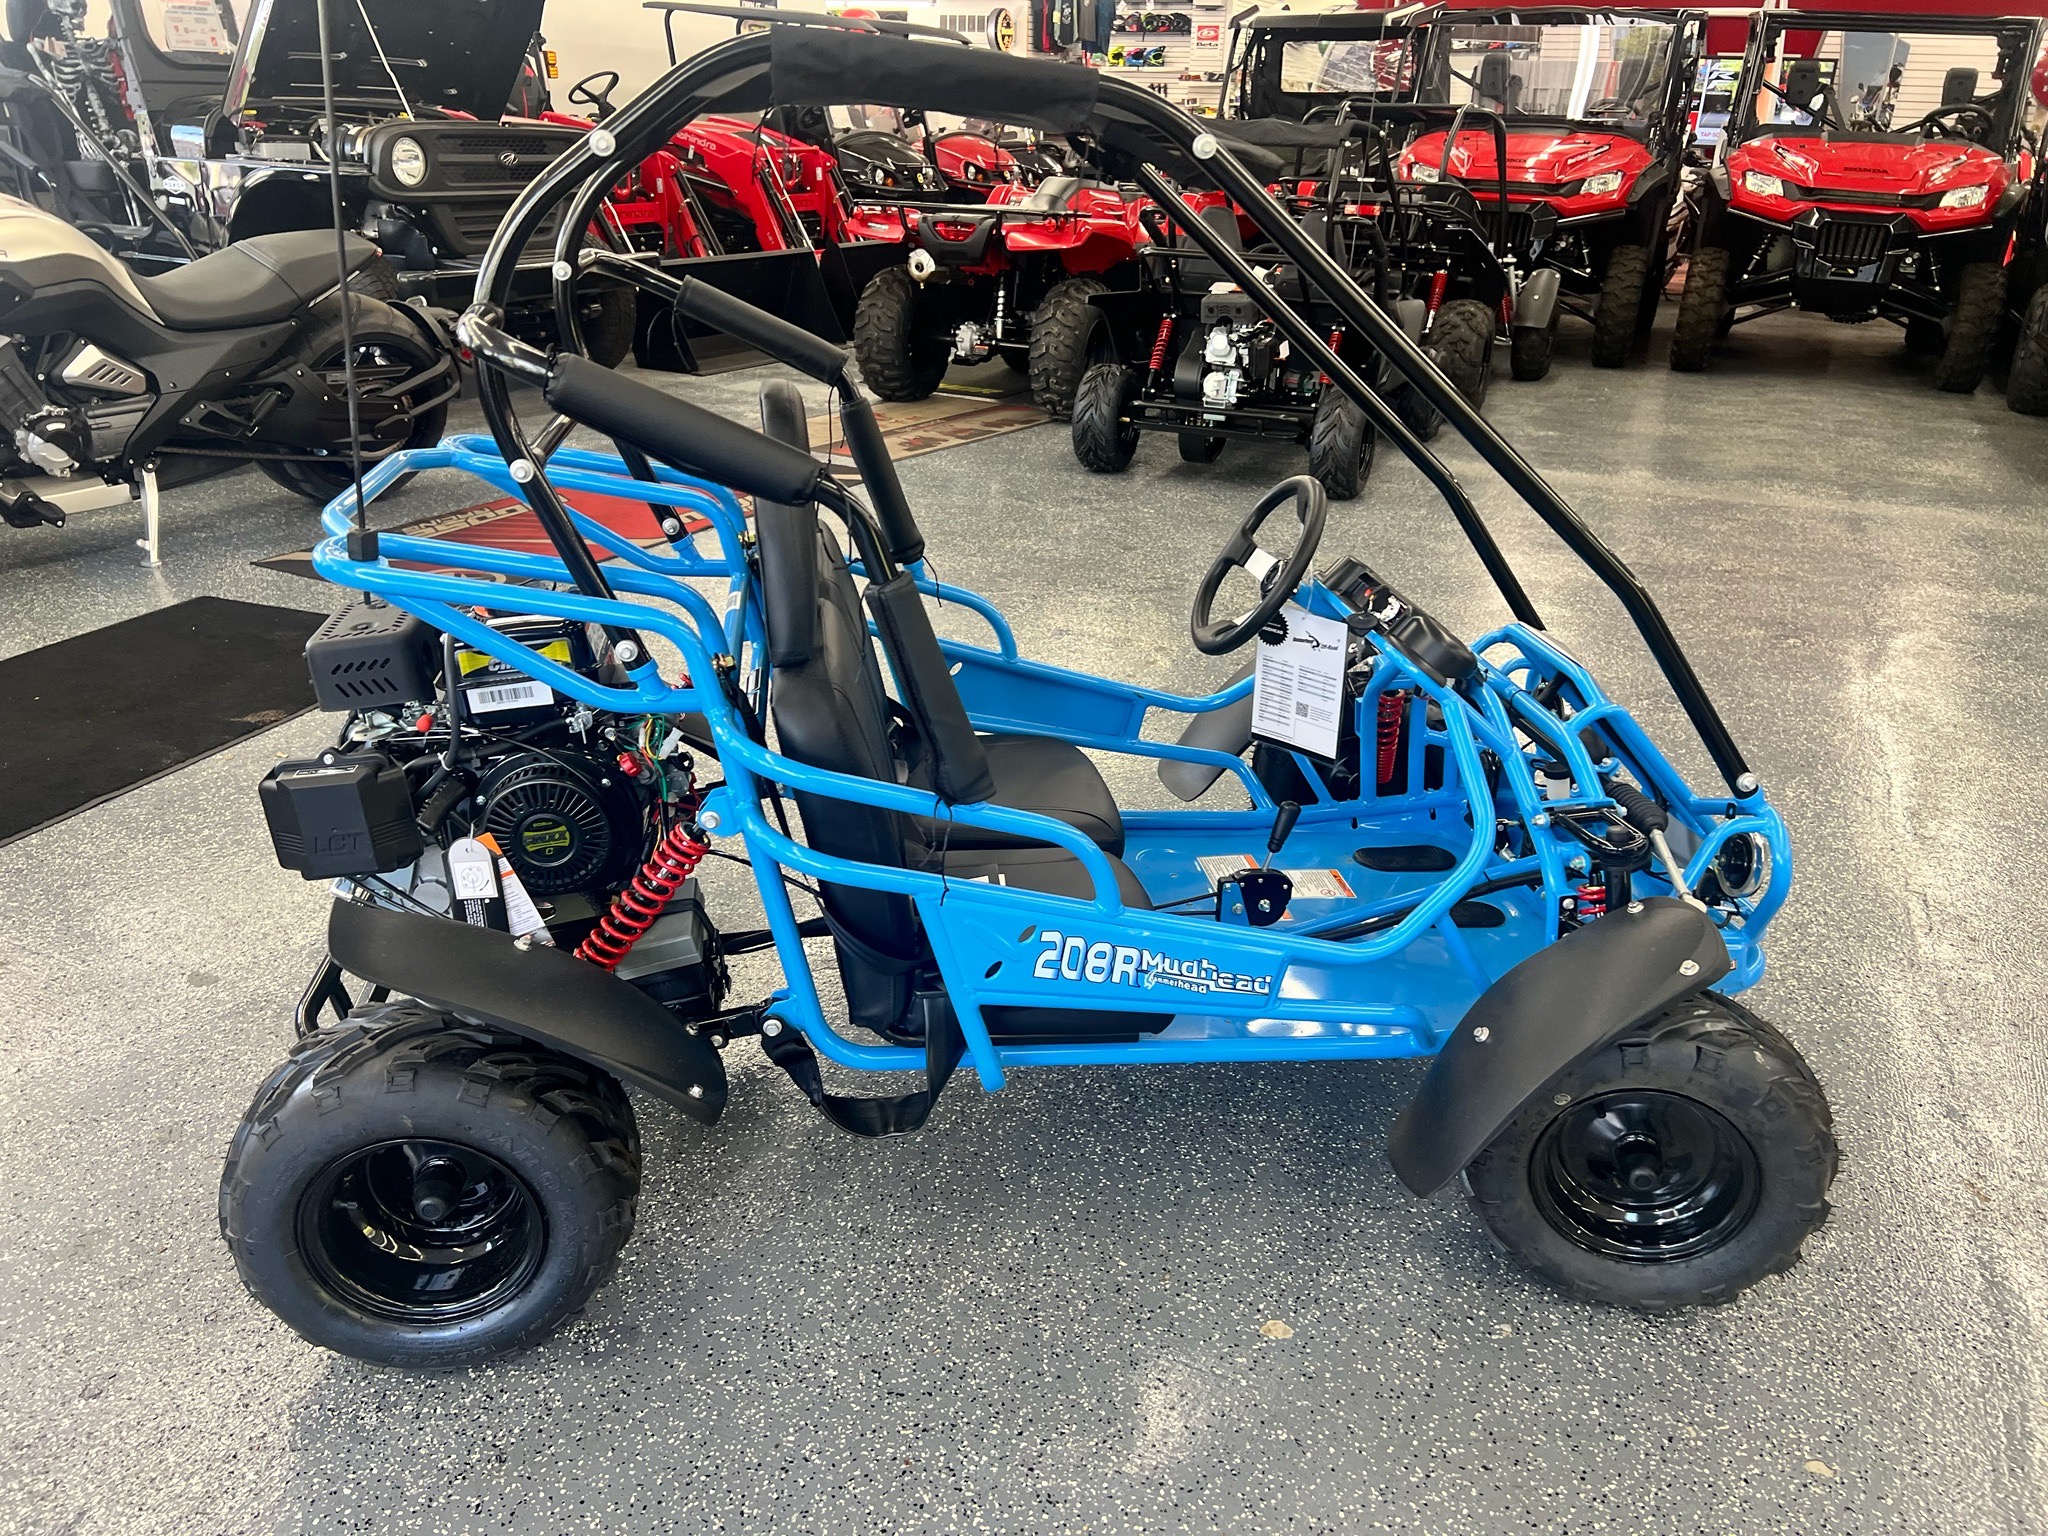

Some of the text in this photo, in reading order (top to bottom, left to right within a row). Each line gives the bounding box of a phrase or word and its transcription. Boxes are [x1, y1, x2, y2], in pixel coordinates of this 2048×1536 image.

[676, 132, 717, 151] ahindra
[1843, 166, 1890, 174] HONDA
[1033, 930, 1273, 994] 208R Mudhead
